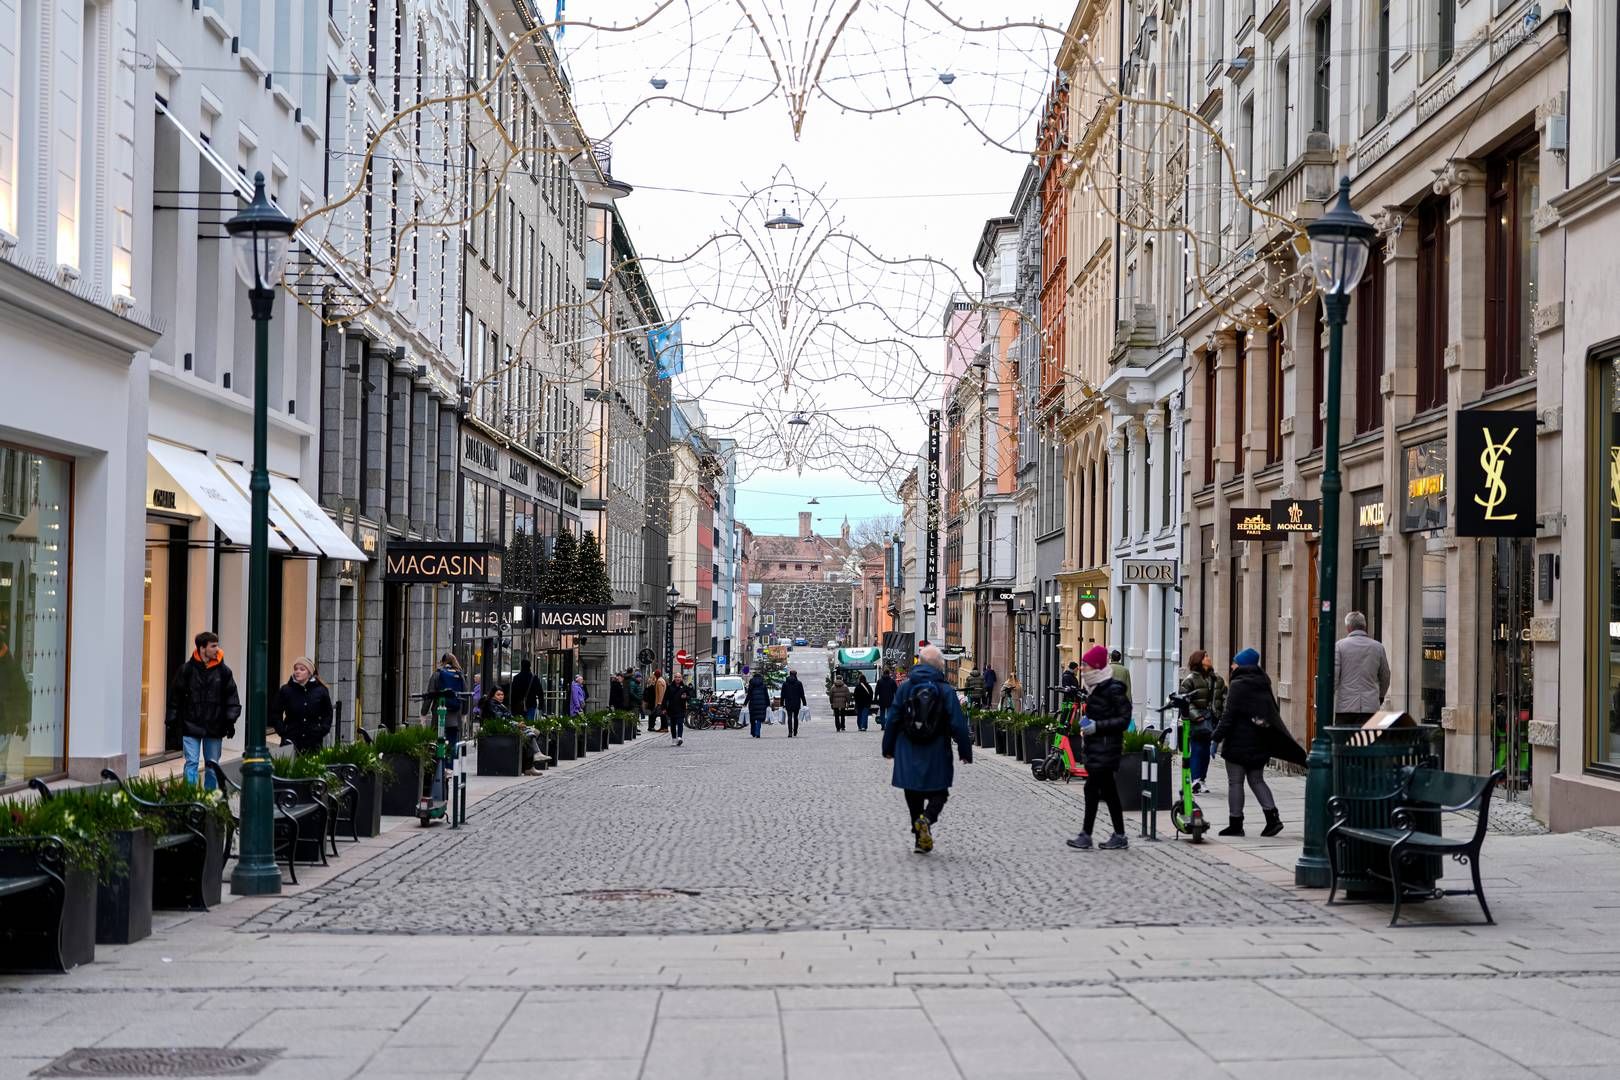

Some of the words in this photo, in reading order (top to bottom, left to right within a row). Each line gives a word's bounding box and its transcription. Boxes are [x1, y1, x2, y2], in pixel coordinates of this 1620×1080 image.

[1474, 427, 1519, 520] YSL
[1277, 523, 1313, 531] MONCLER
[387, 555, 484, 576] MAGASIN
[1126, 564, 1173, 580] DIOR
[541, 612, 605, 626] MAGASIN
